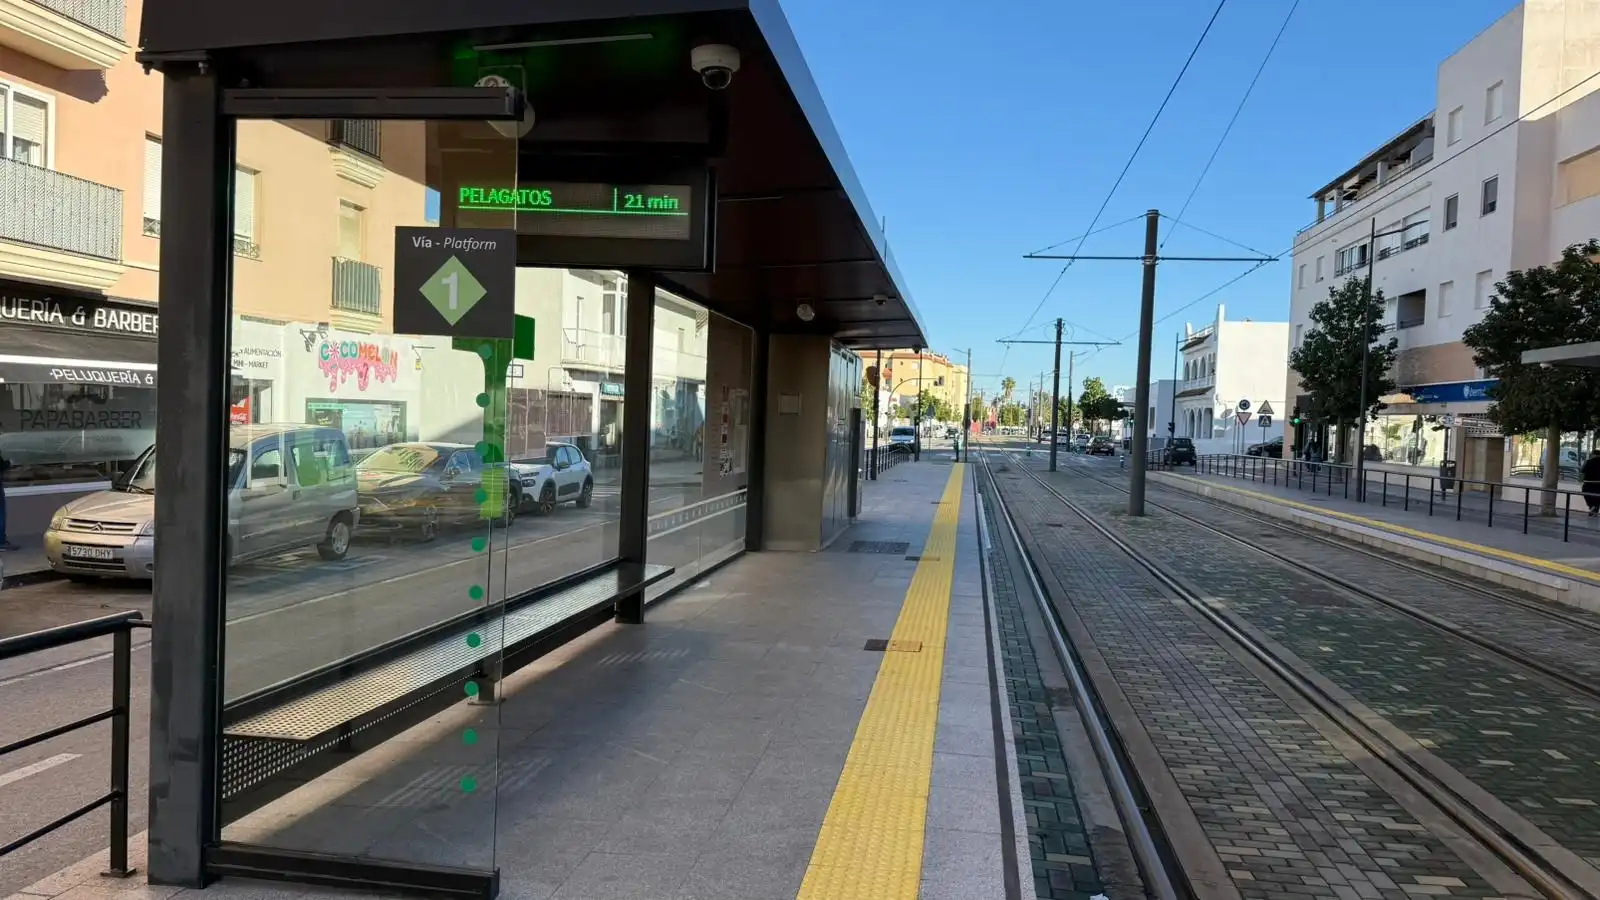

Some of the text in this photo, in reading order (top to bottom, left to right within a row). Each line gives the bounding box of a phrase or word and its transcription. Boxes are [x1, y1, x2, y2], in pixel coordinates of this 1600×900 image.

[459, 187, 678, 209] PELAGATOS 21 min
[412, 235, 432, 248] Vía
[443, 236, 497, 252] Platform
[441, 272, 458, 310] 1
[0, 296, 64, 324] UERÍA
[319, 340, 398, 368] COCOMELON
[20, 409, 142, 431] PAPABARBER
